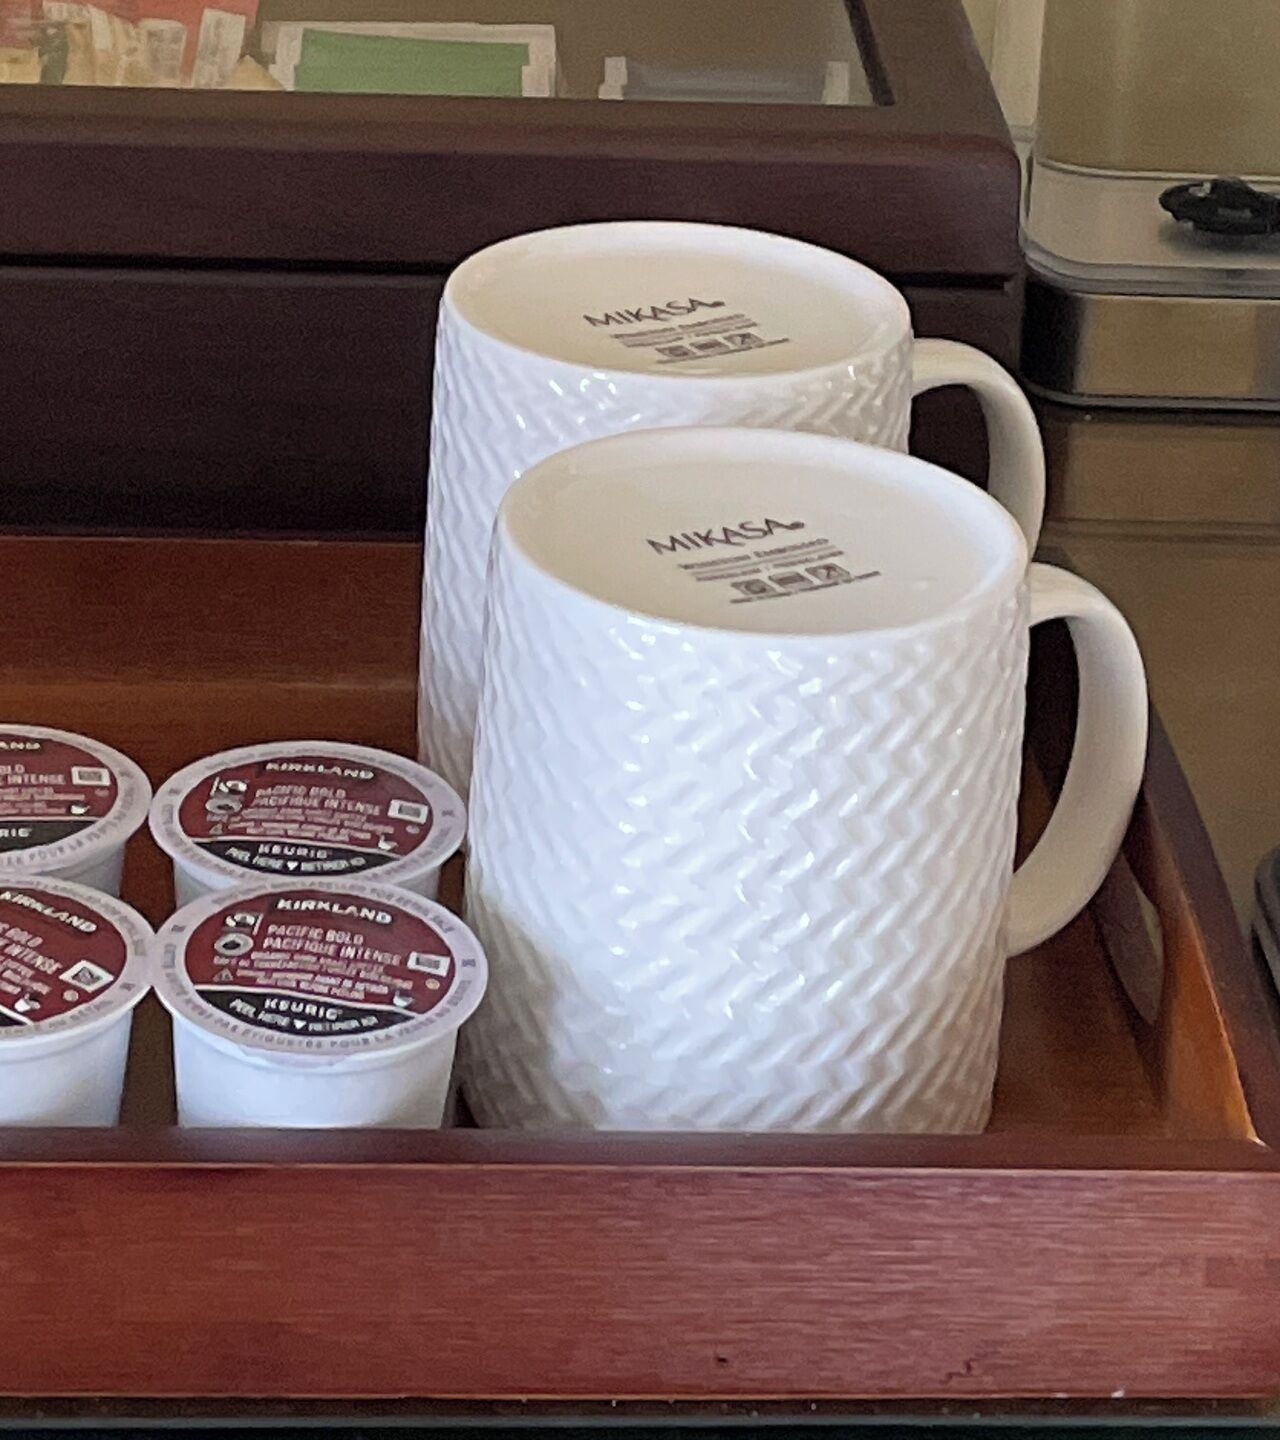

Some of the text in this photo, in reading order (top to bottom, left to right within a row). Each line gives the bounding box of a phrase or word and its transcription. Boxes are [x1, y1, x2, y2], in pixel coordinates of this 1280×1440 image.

[583, 298, 719, 327] MIKASA
[646, 518, 798, 555] MIKASA
[7, 773, 67, 786] INTENSE
[266, 762, 374, 779] KIRKLAND
[255, 784, 306, 798] PACIFIC
[251, 795, 381, 815] PACIFIQUE INTENSE
[258, 844, 328, 859] KEURIG
[0, 890, 97, 933] KIRKLAND
[277, 898, 392, 924] KIRKLAND
[267, 924, 364, 945] PACIFIC BOLD
[4, 941, 62, 975] INTENSE
[263, 936, 402, 965] PACIFIQUE INTENSE
[264, 998, 338, 1020] KEURIG
